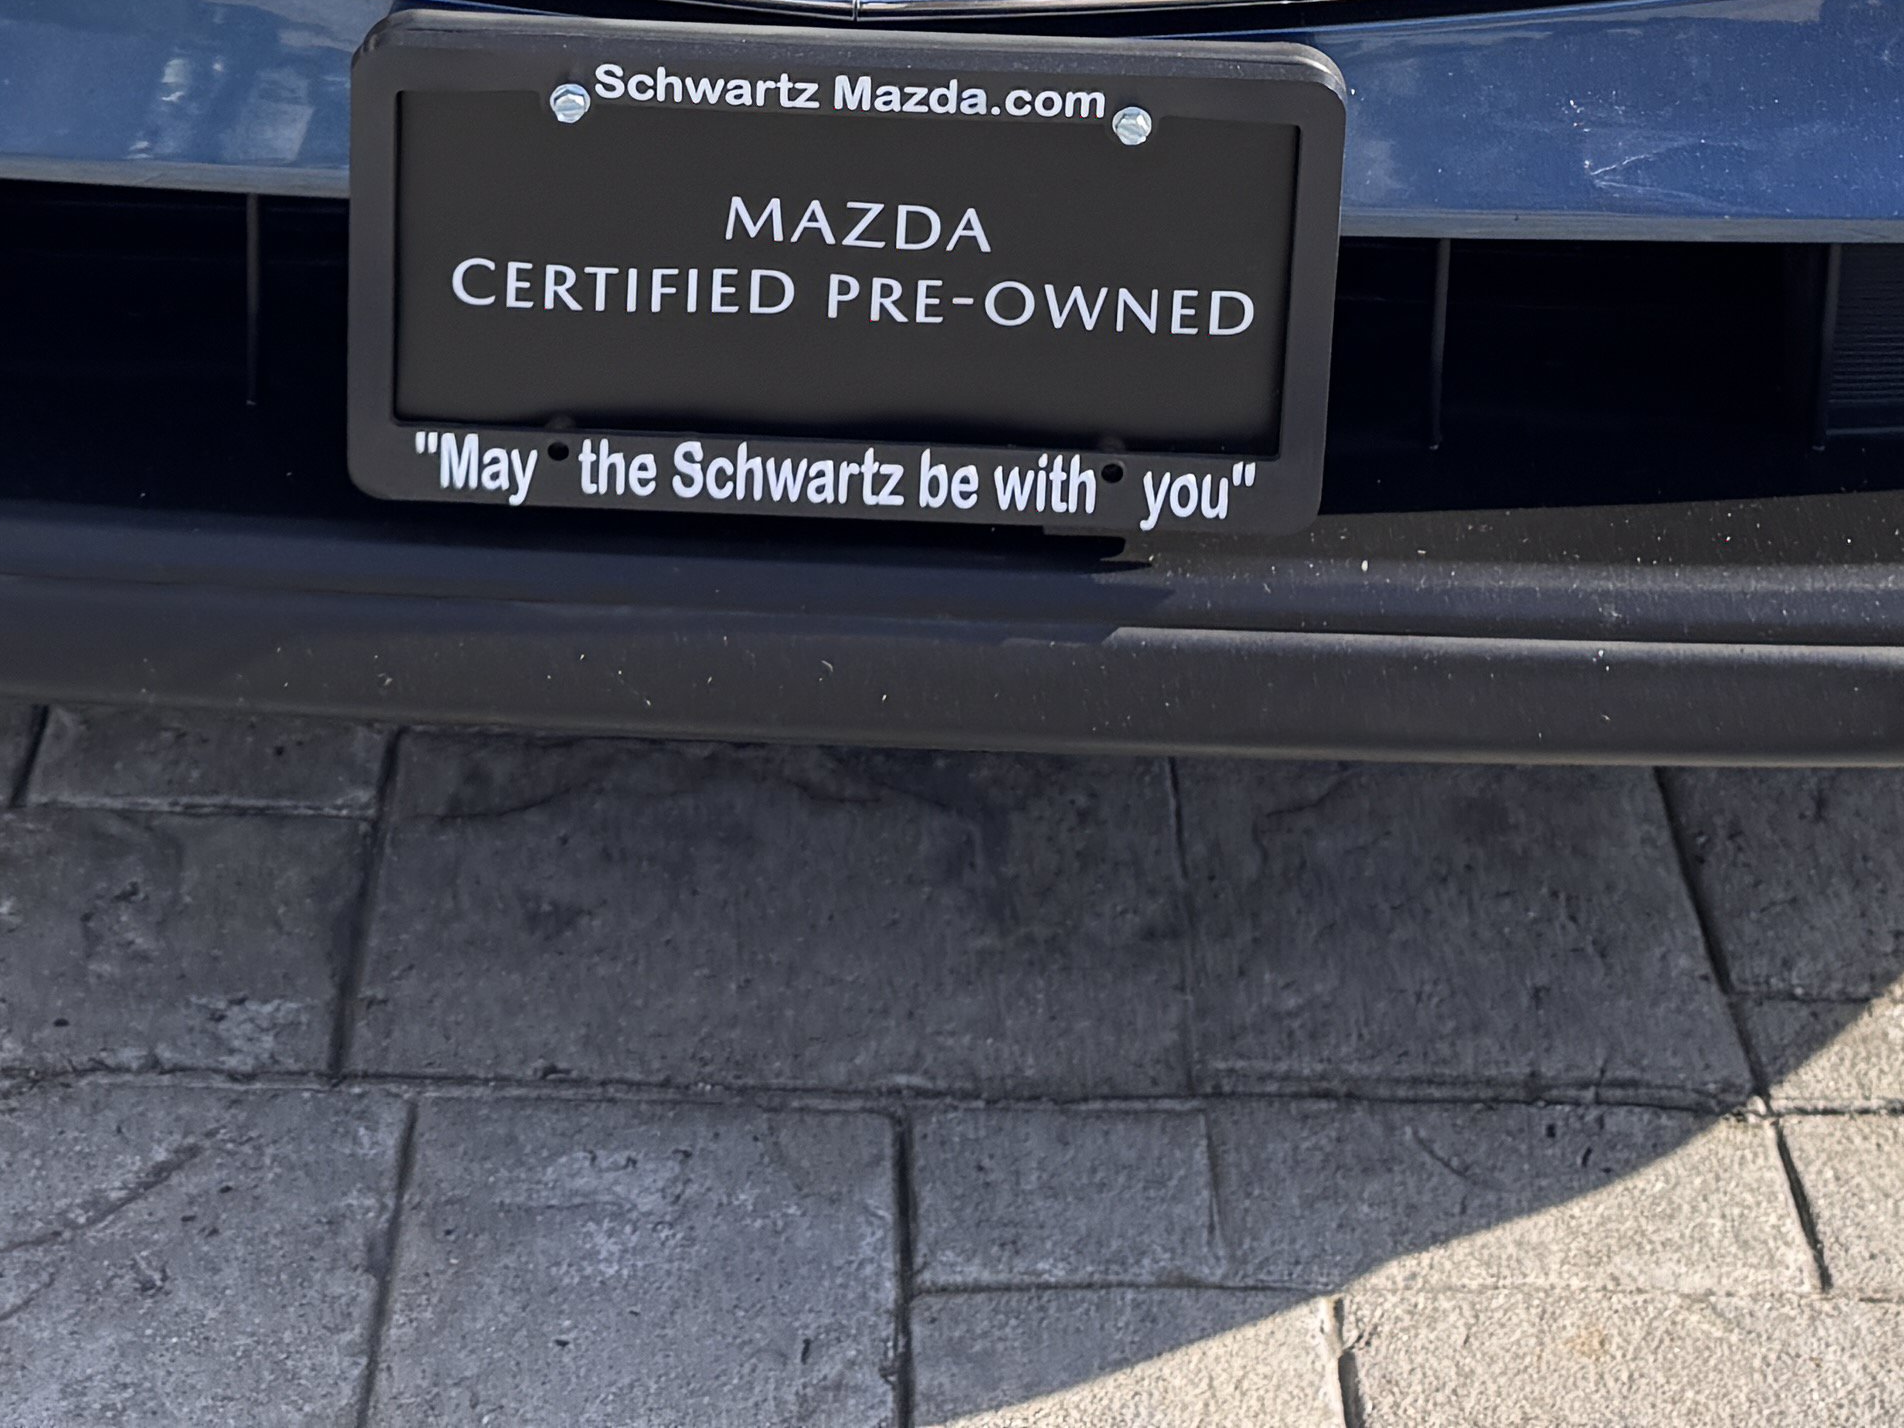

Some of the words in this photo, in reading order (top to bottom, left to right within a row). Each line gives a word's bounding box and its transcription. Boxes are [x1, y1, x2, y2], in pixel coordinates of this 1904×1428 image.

[594, 63, 820, 109] Schwartz
[833, 74, 1107, 119] Mazda.com
[725, 196, 991, 253] MAZDA
[452, 257, 795, 314] CERTIFIED
[827, 273, 1254, 335] PRE-OWNED
[415, 431, 538, 506] "May
[578, 438, 657, 497] the
[672, 440, 905, 506] Schwartz
[919, 448, 979, 509] be
[993, 453, 1097, 514] with
[1139, 461, 1256, 531] you"
